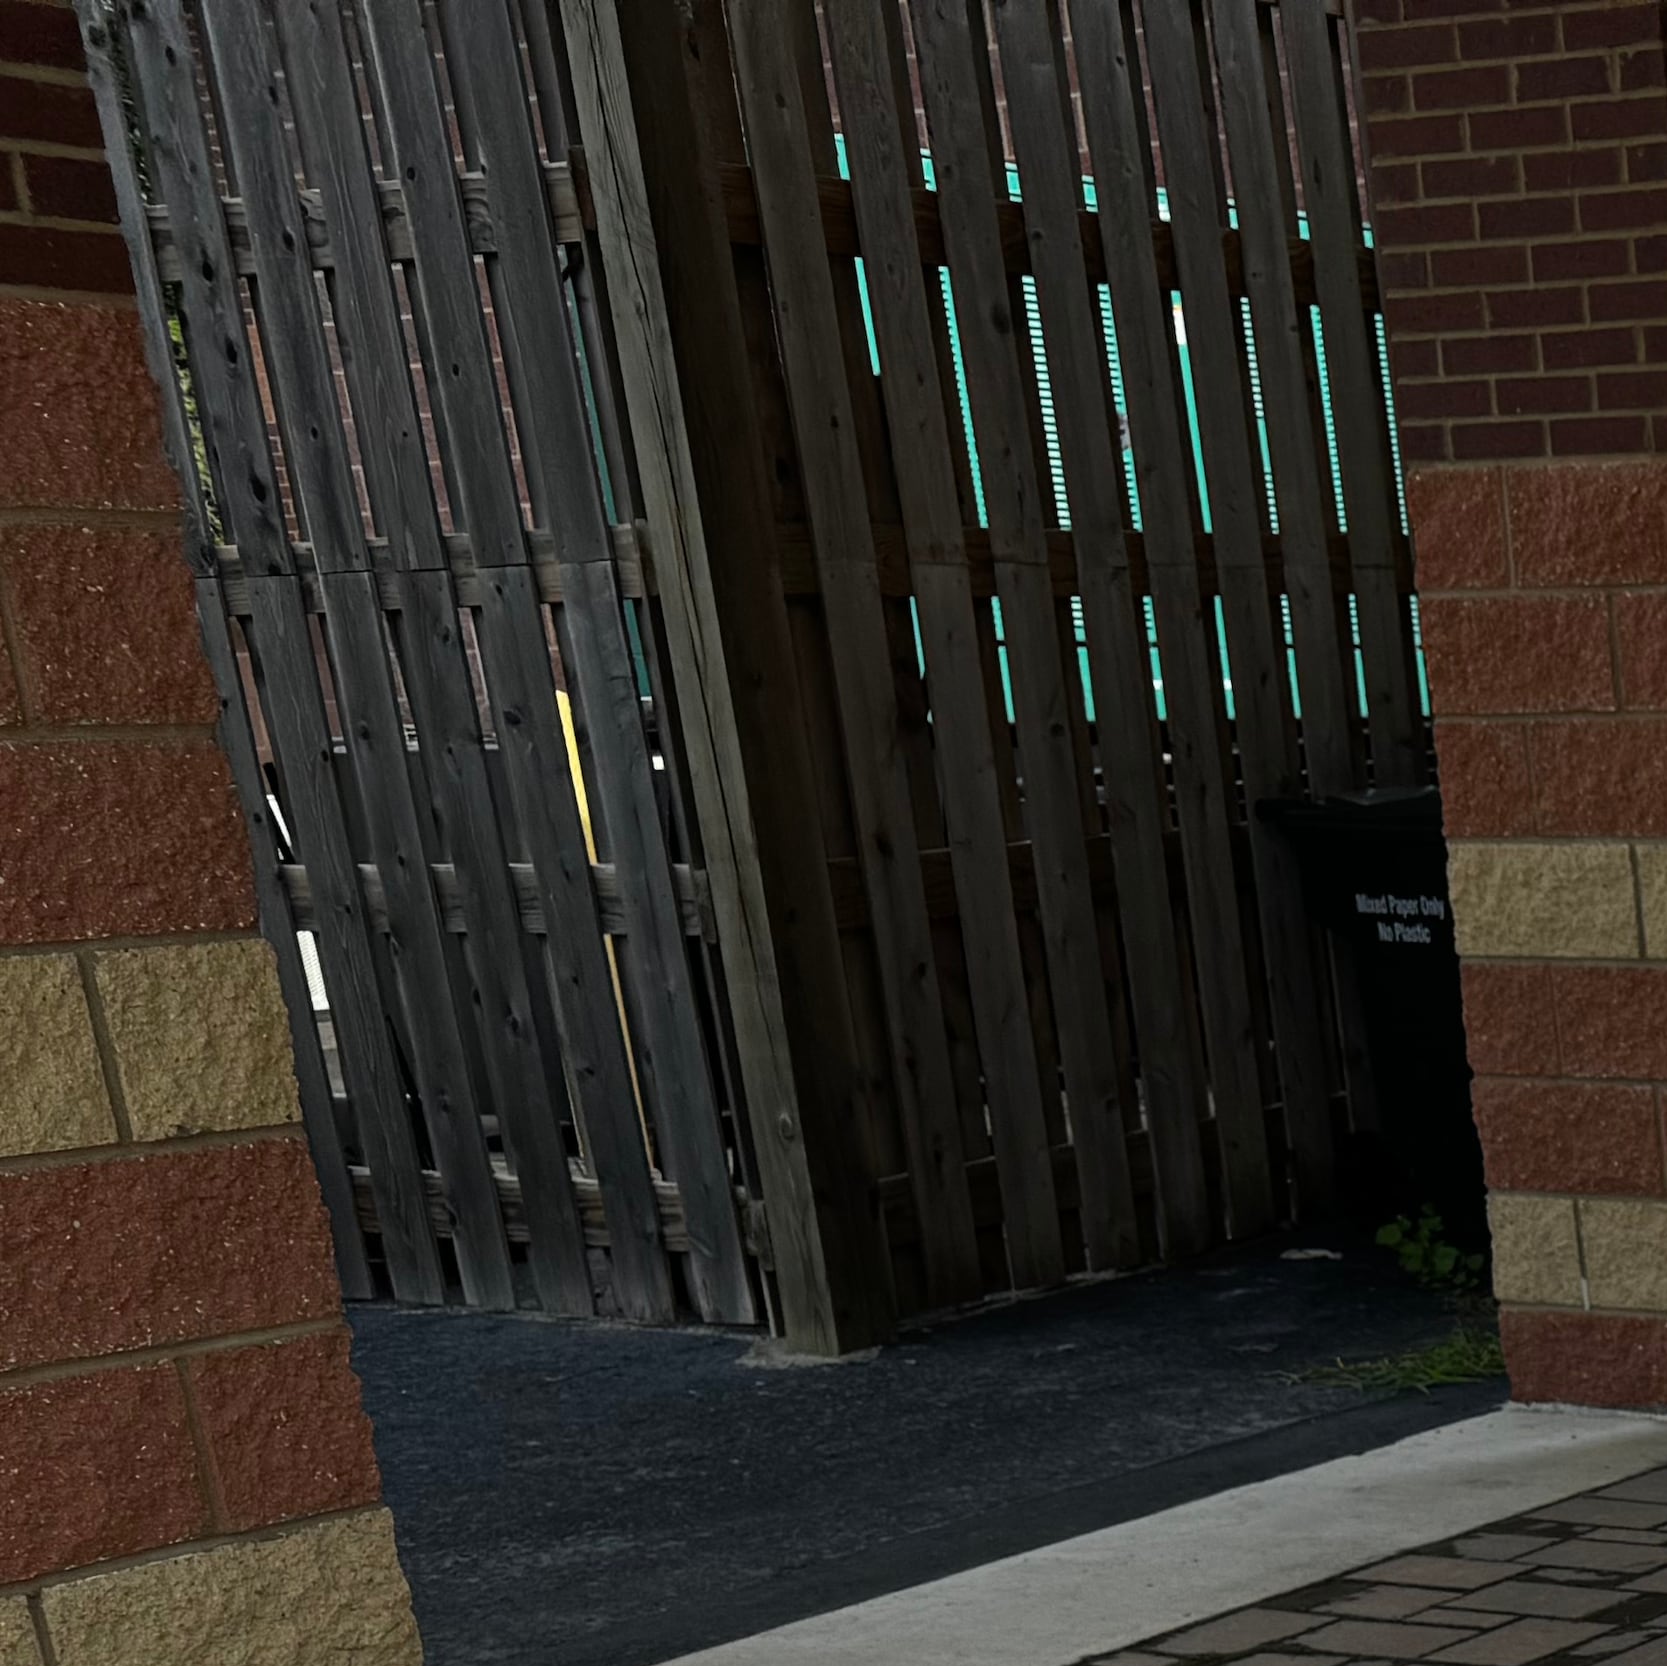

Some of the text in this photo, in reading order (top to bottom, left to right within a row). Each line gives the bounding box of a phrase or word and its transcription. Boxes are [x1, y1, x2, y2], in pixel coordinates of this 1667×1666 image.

[1354, 893, 1446, 921] Mixed Paper Only
[1377, 920, 1432, 944] No Plastic
